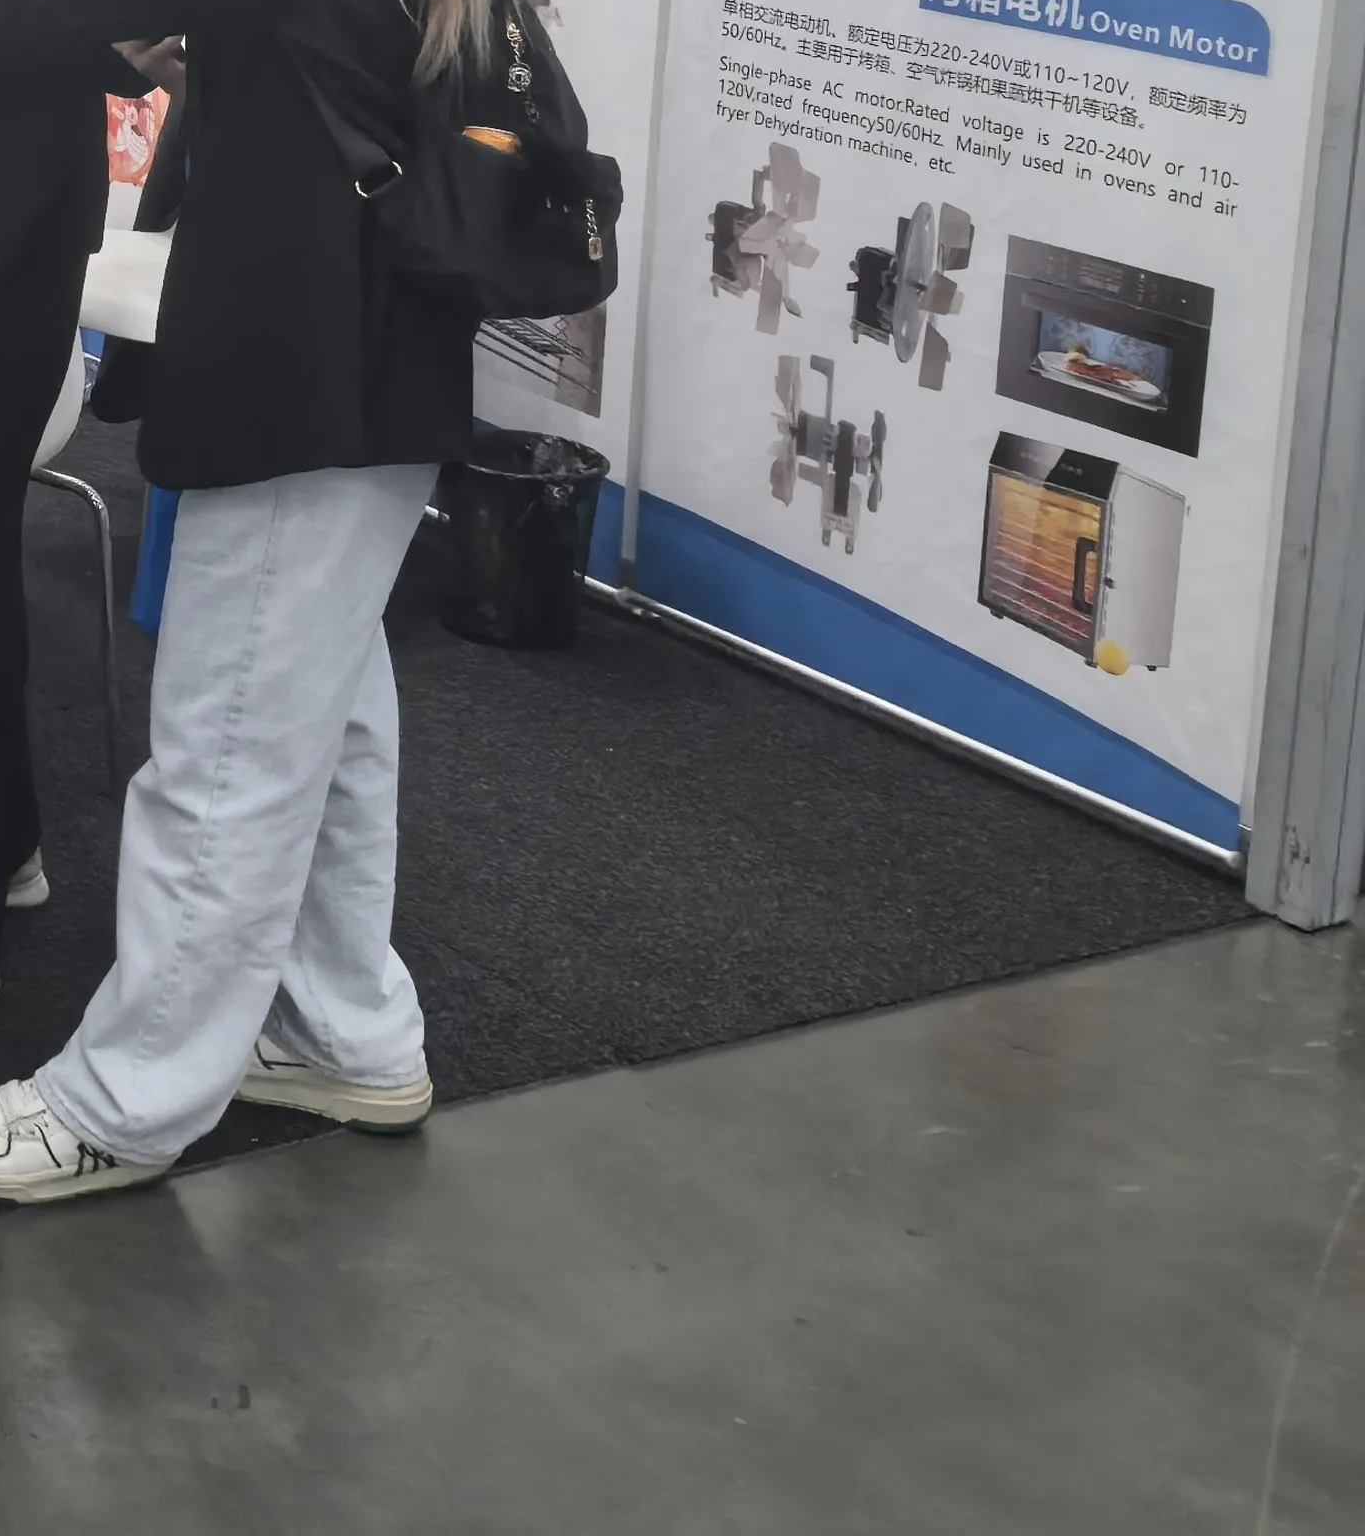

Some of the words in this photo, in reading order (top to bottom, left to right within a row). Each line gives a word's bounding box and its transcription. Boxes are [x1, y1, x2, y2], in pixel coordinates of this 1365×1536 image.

[1091, 11, 1160, 43] Oven
[1168, 26, 1259, 64] Motor
[717, 100, 751, 122] fryer
[755, 110, 843, 146] Dehydration
[719, 56, 811, 91] Single-phase
[823, 80, 843, 98] AC
[963, 114, 1023, 142] voltage
[1037, 128, 1049, 146] is
[1165, 162, 1185, 177] or
[957, 136, 1011, 166] Mainly
[1023, 154, 1063, 175] used
[1076, 162, 1091, 180] in
[1104, 174, 1155, 196] ovens
[1168, 189, 1203, 208] and
[1214, 198, 1237, 217] air
